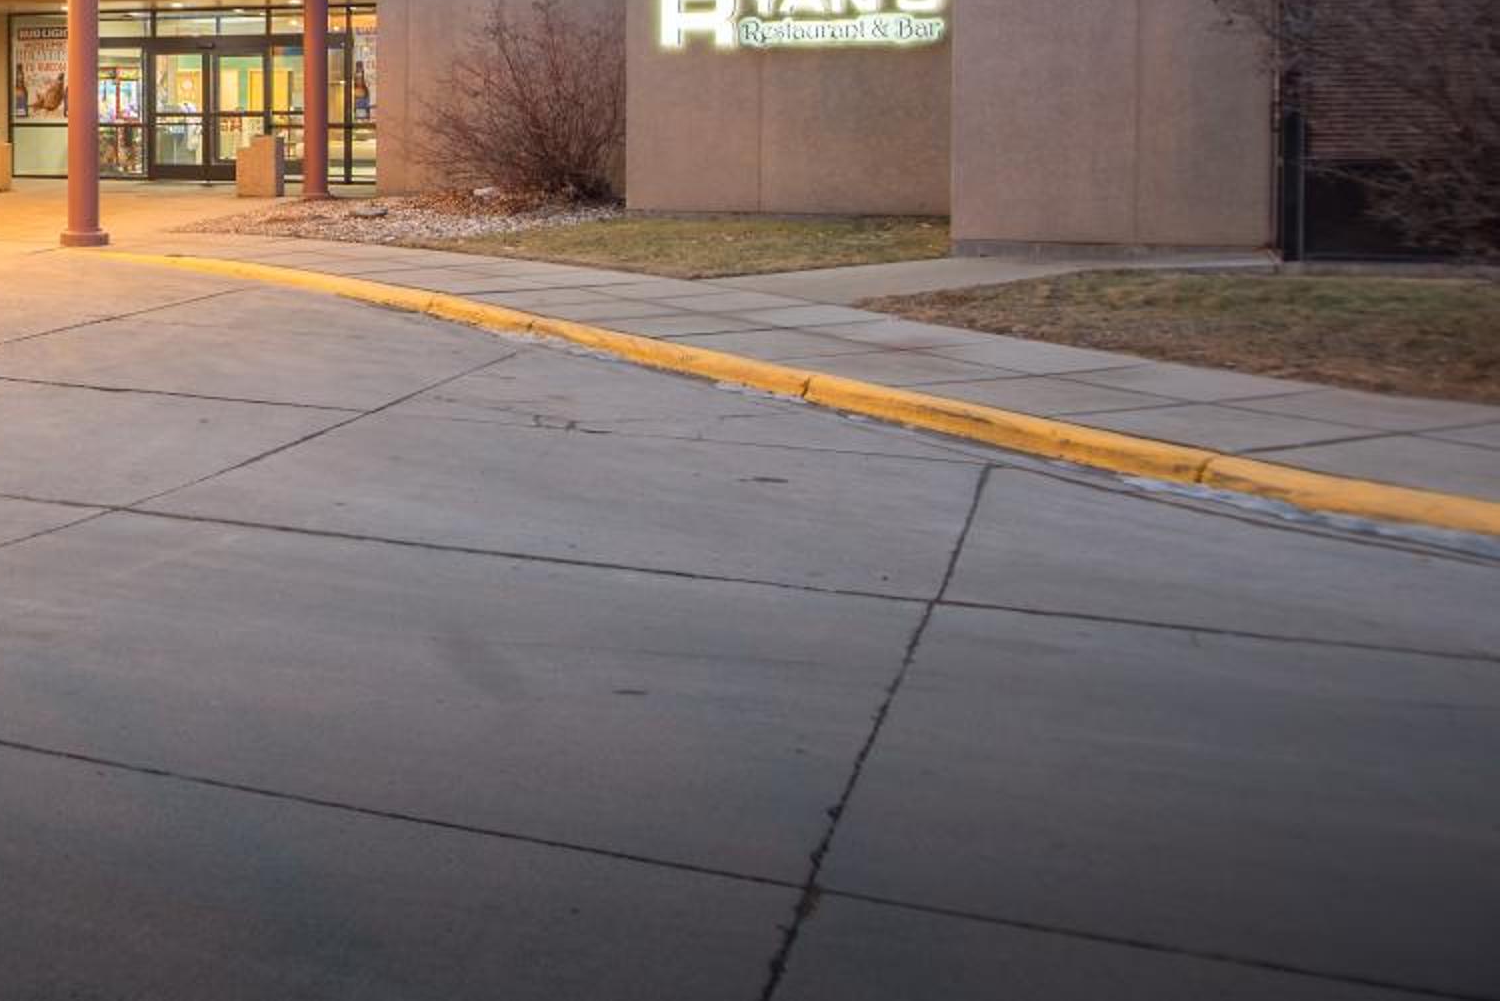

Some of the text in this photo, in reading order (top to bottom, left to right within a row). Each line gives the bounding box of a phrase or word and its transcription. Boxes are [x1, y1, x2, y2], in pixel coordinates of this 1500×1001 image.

[741, 16, 943, 43] Restaurant & Bar
